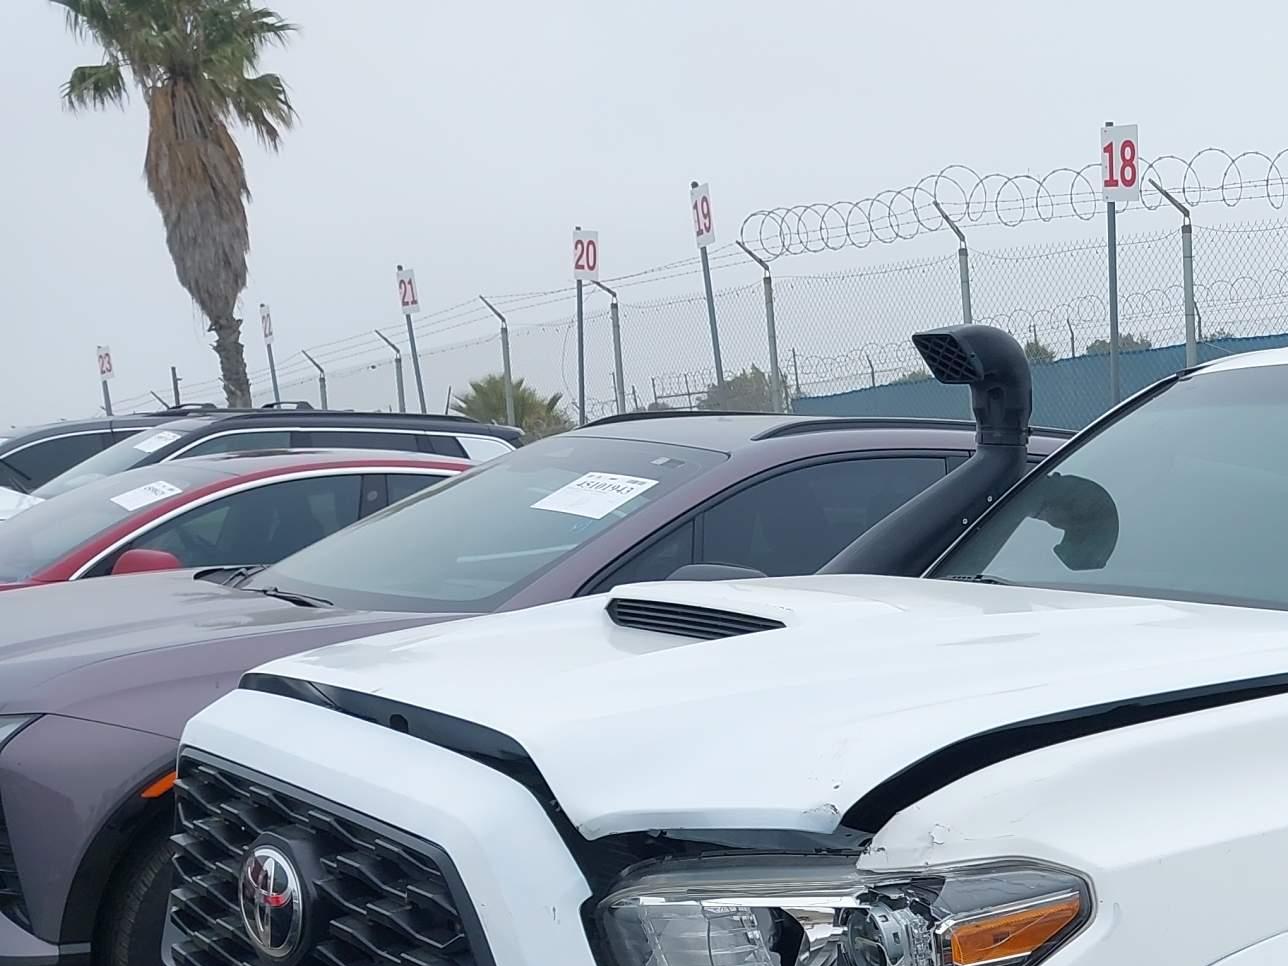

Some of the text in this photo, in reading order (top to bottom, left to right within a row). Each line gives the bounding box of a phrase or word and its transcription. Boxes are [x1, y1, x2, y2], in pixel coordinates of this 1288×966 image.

[1103, 139, 1137, 189] 18
[693, 195, 711, 236] 19
[574, 239, 597, 271] 20
[399, 278, 418, 306] 21
[262, 313, 273, 339] 22
[99, 352, 113, 375] 23
